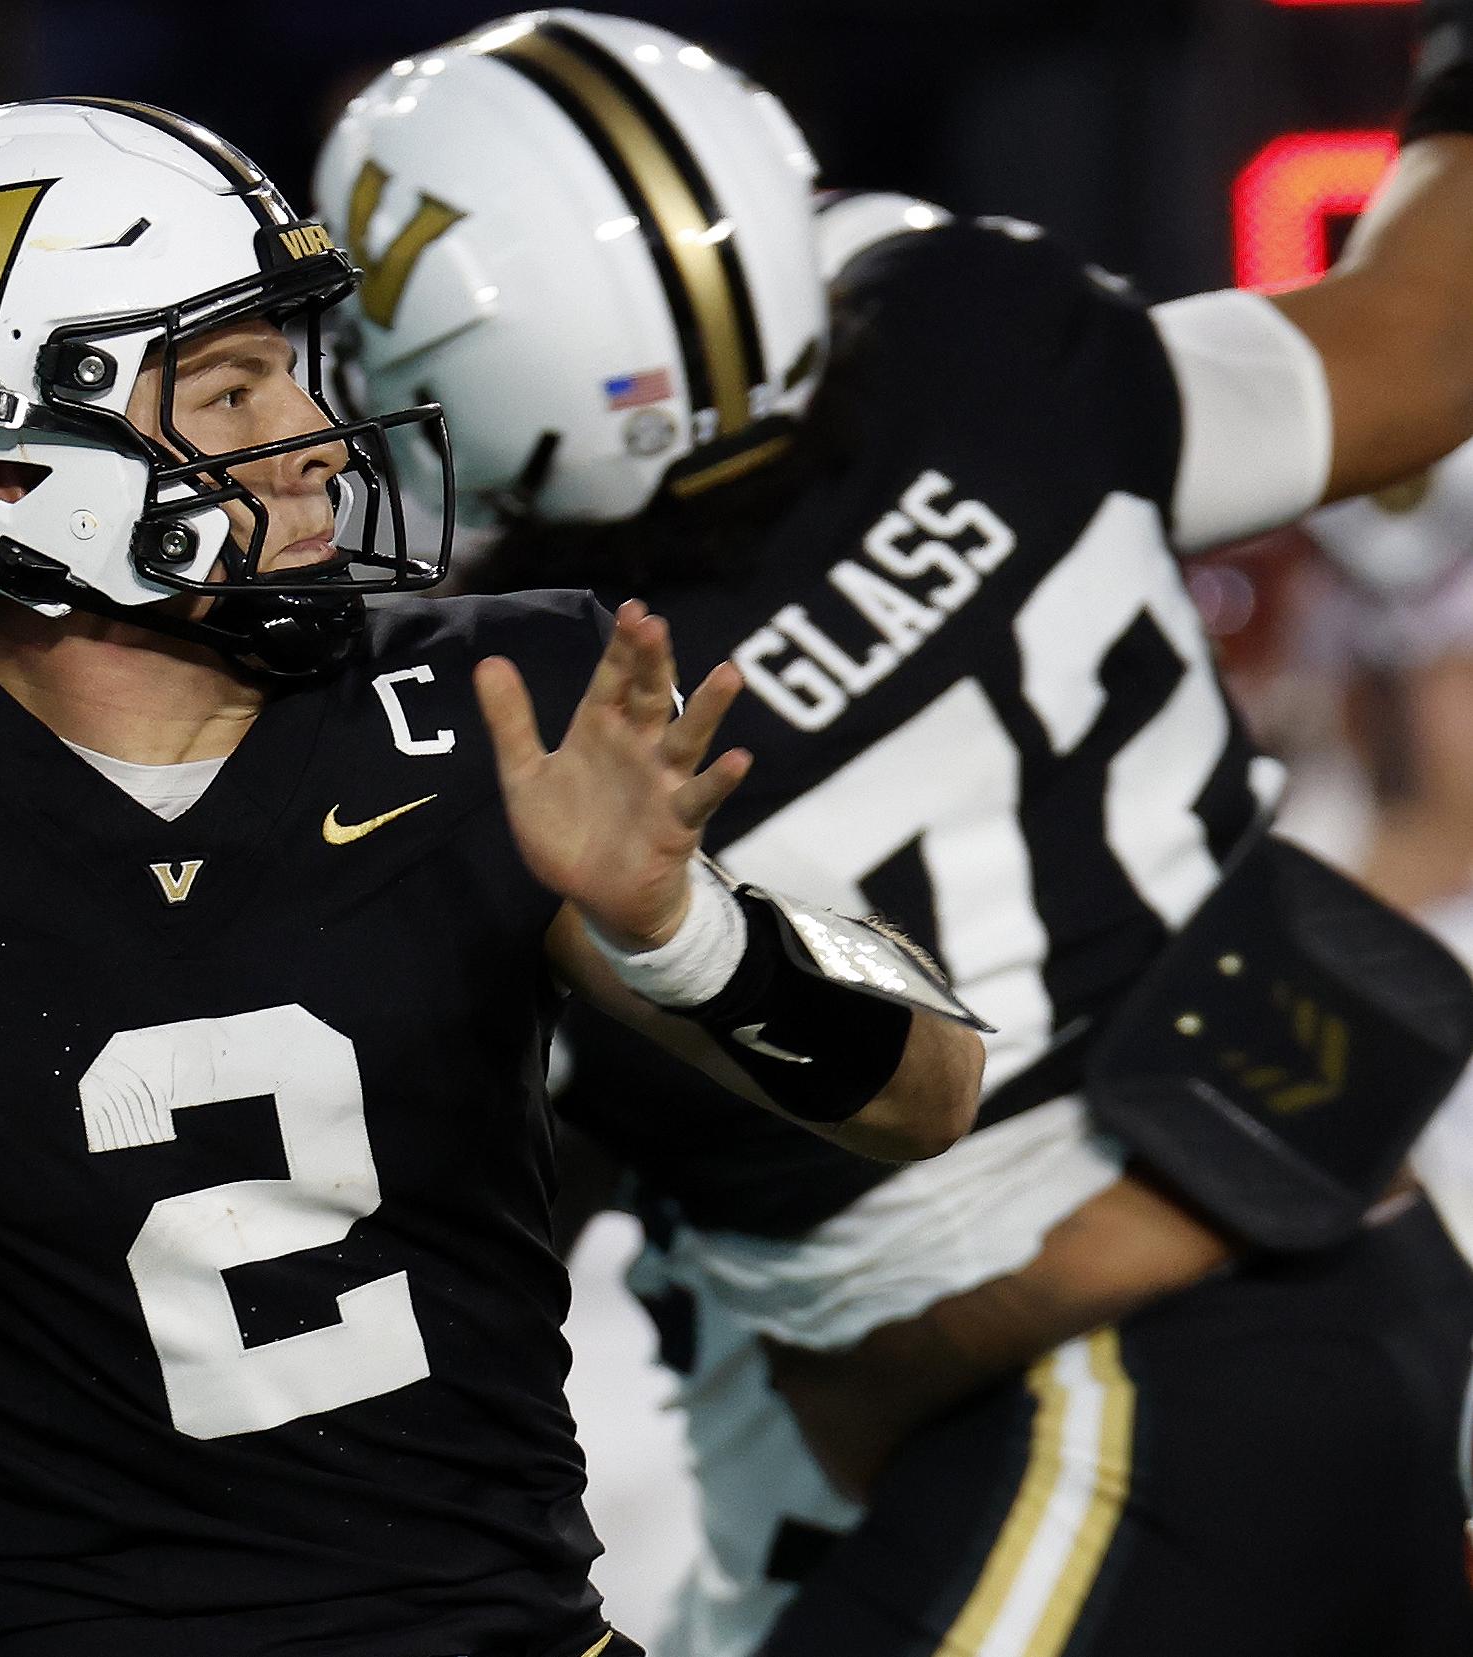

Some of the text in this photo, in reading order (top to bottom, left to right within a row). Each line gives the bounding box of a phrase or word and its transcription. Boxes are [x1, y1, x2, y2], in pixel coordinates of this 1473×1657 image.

[346, 158, 471, 330] V
[733, 469, 1017, 732] GLASS
[372, 664, 455, 756] C
[716, 490, 1288, 1100] 72
[149, 859, 204, 903] V
[78, 1003, 430, 1440] 2
